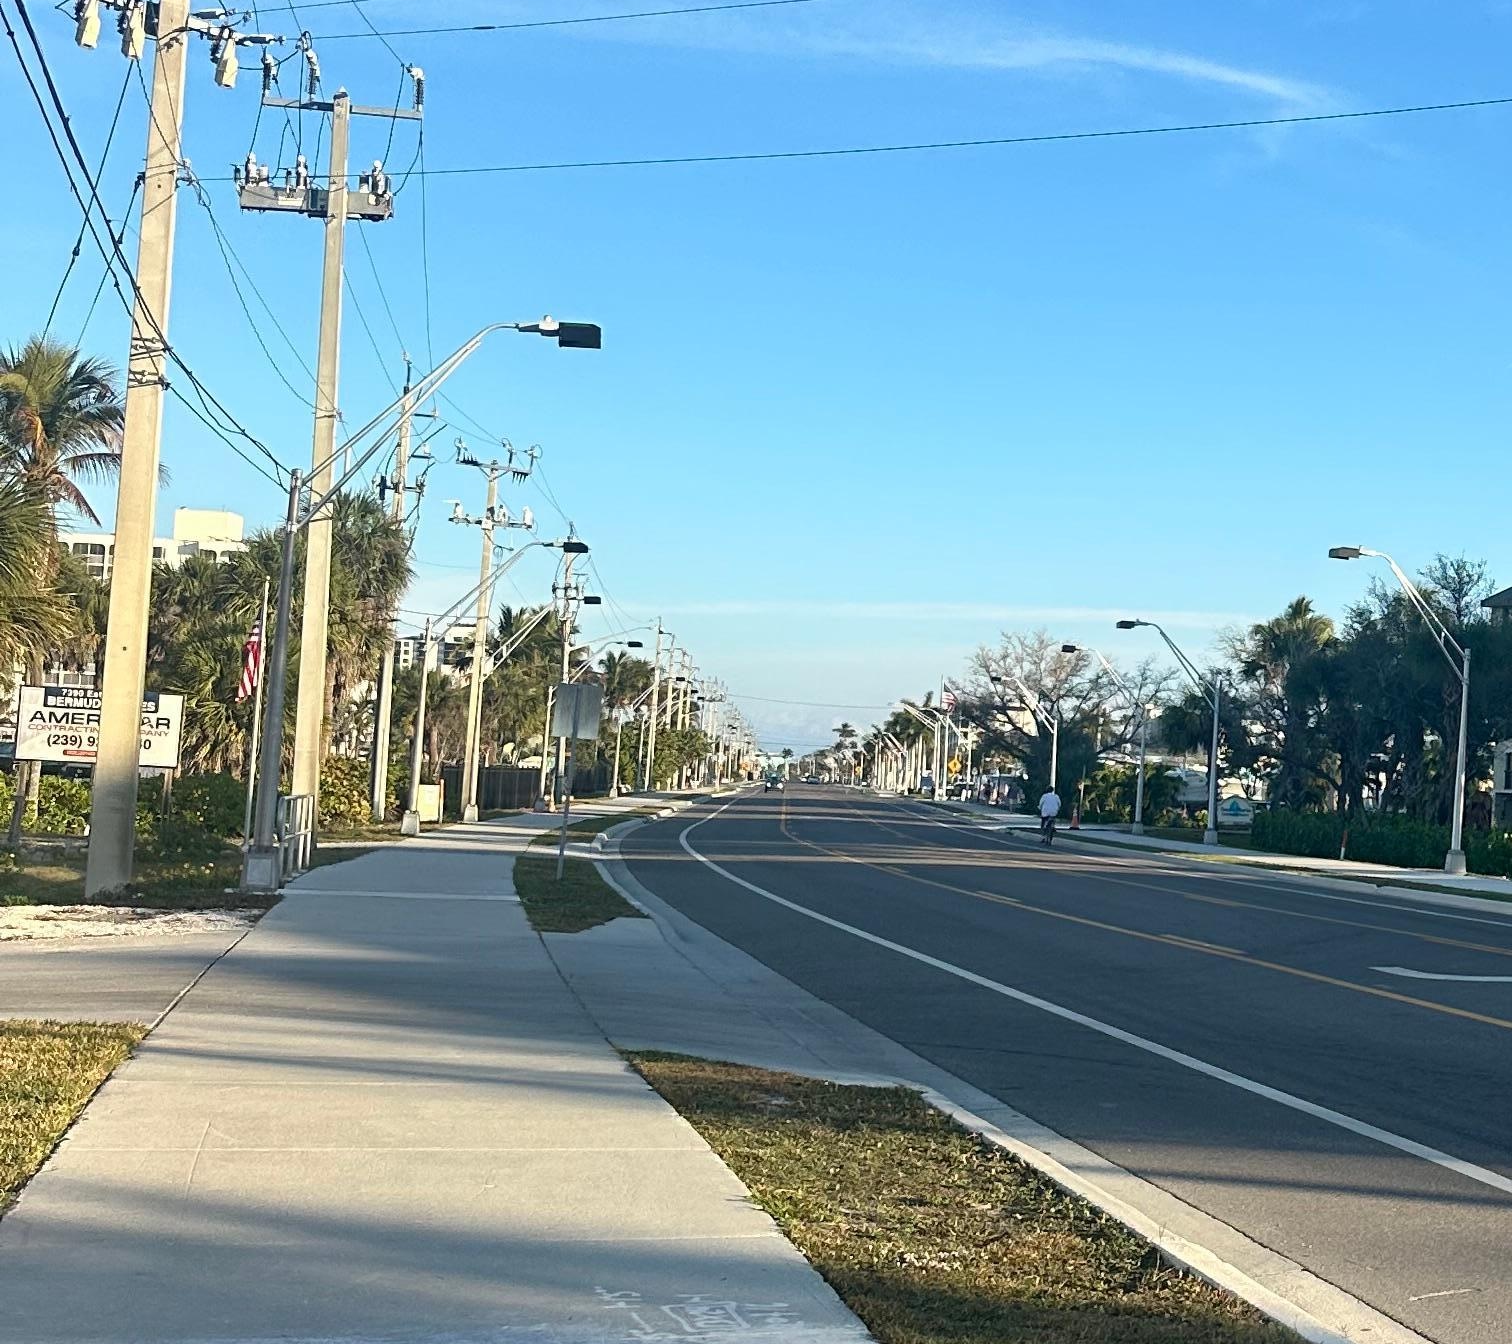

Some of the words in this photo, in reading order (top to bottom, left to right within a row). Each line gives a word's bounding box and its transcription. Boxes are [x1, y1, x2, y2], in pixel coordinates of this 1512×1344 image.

[47, 696, 101, 709] BERMUD
[28, 724, 99, 733] CONTRACTIN
[47, 734, 82, 748] (239)
